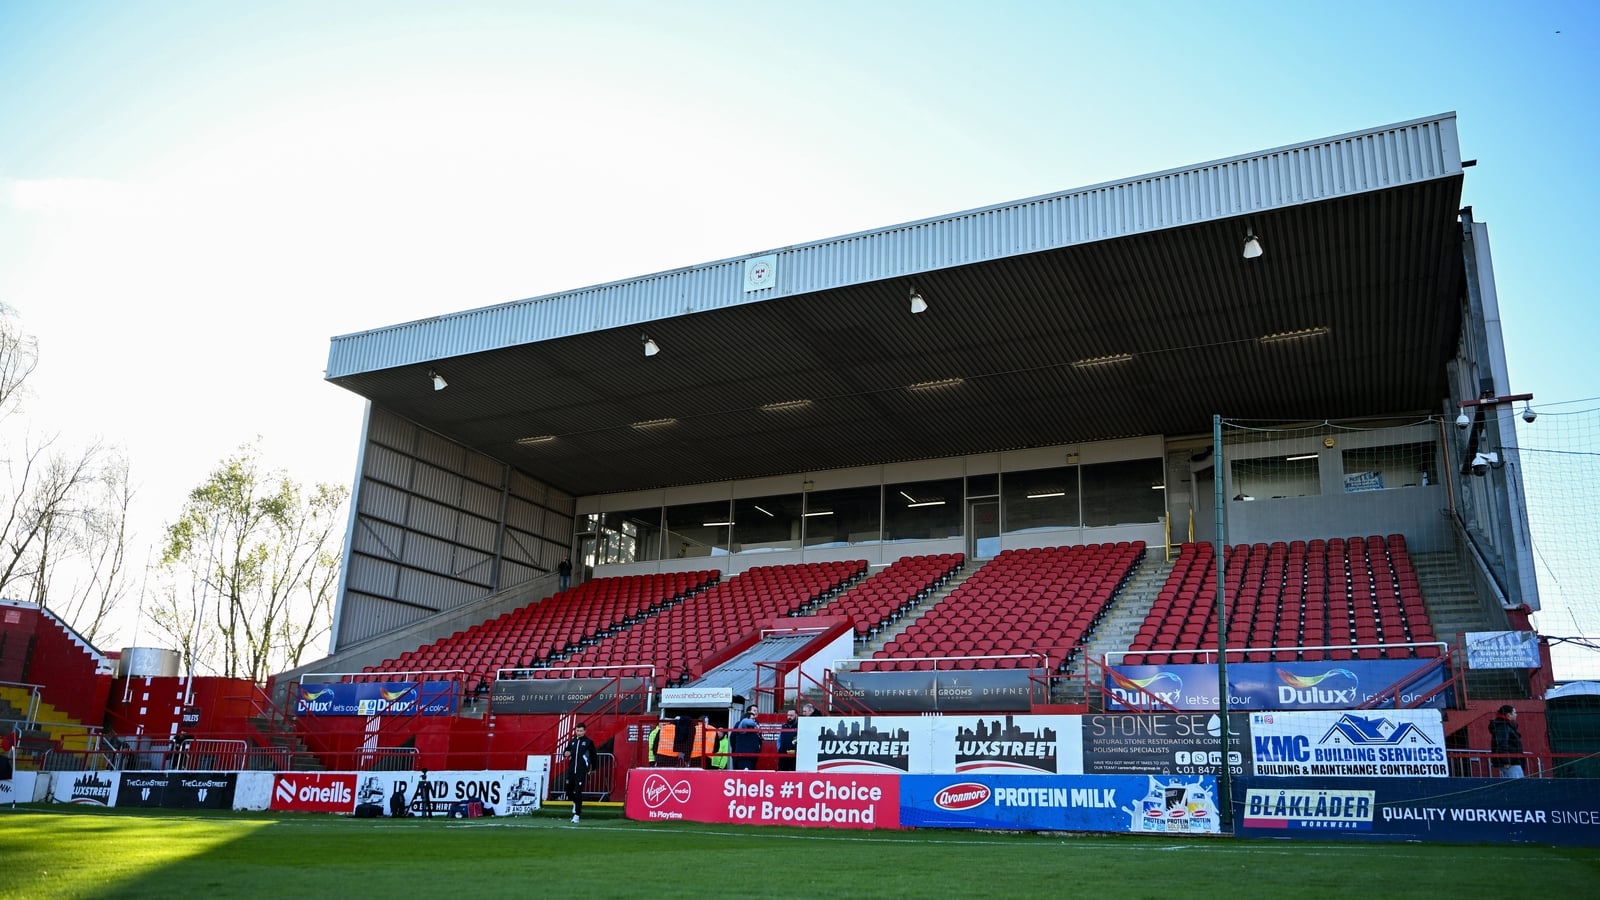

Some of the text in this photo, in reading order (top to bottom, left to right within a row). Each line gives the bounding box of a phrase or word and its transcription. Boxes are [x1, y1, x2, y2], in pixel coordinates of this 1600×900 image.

[938, 688, 973, 696] GROOMS
[1186, 695, 1209, 705] let's
[1212, 695, 1251, 705] clour
[1278, 685, 1349, 704] Dulux
[183, 714, 199, 722] TOILETS
[1092, 715, 1168, 737] STONE
[818, 741, 909, 756] LUXSTREET
[956, 741, 1057, 757] LUXSTREET
[1254, 735, 1444, 762] KMC BUILDING SERVICES
[1184, 766, 1195, 774] 01
[1199, 766, 1215, 774] 847
[1257, 764, 1447, 776] BUILDING & MAINTENANCE CONTRACTOR
[455, 780, 500, 804] SONS
[646, 780, 667, 802] Virgin
[723, 778, 882, 801] Shels #1 Choice
[994, 787, 1067, 807] PROTEIN
[1071, 788, 1116, 808] MILK
[728, 800, 874, 824] for Broadband
[1249, 790, 1370, 818] BLÅKLÄDER
[657, 811, 683, 820] Playtime
[1301, 820, 1357, 829] WORKWEAR
[1382, 807, 1600, 825] QUALITY WORKWEAR SINCE
